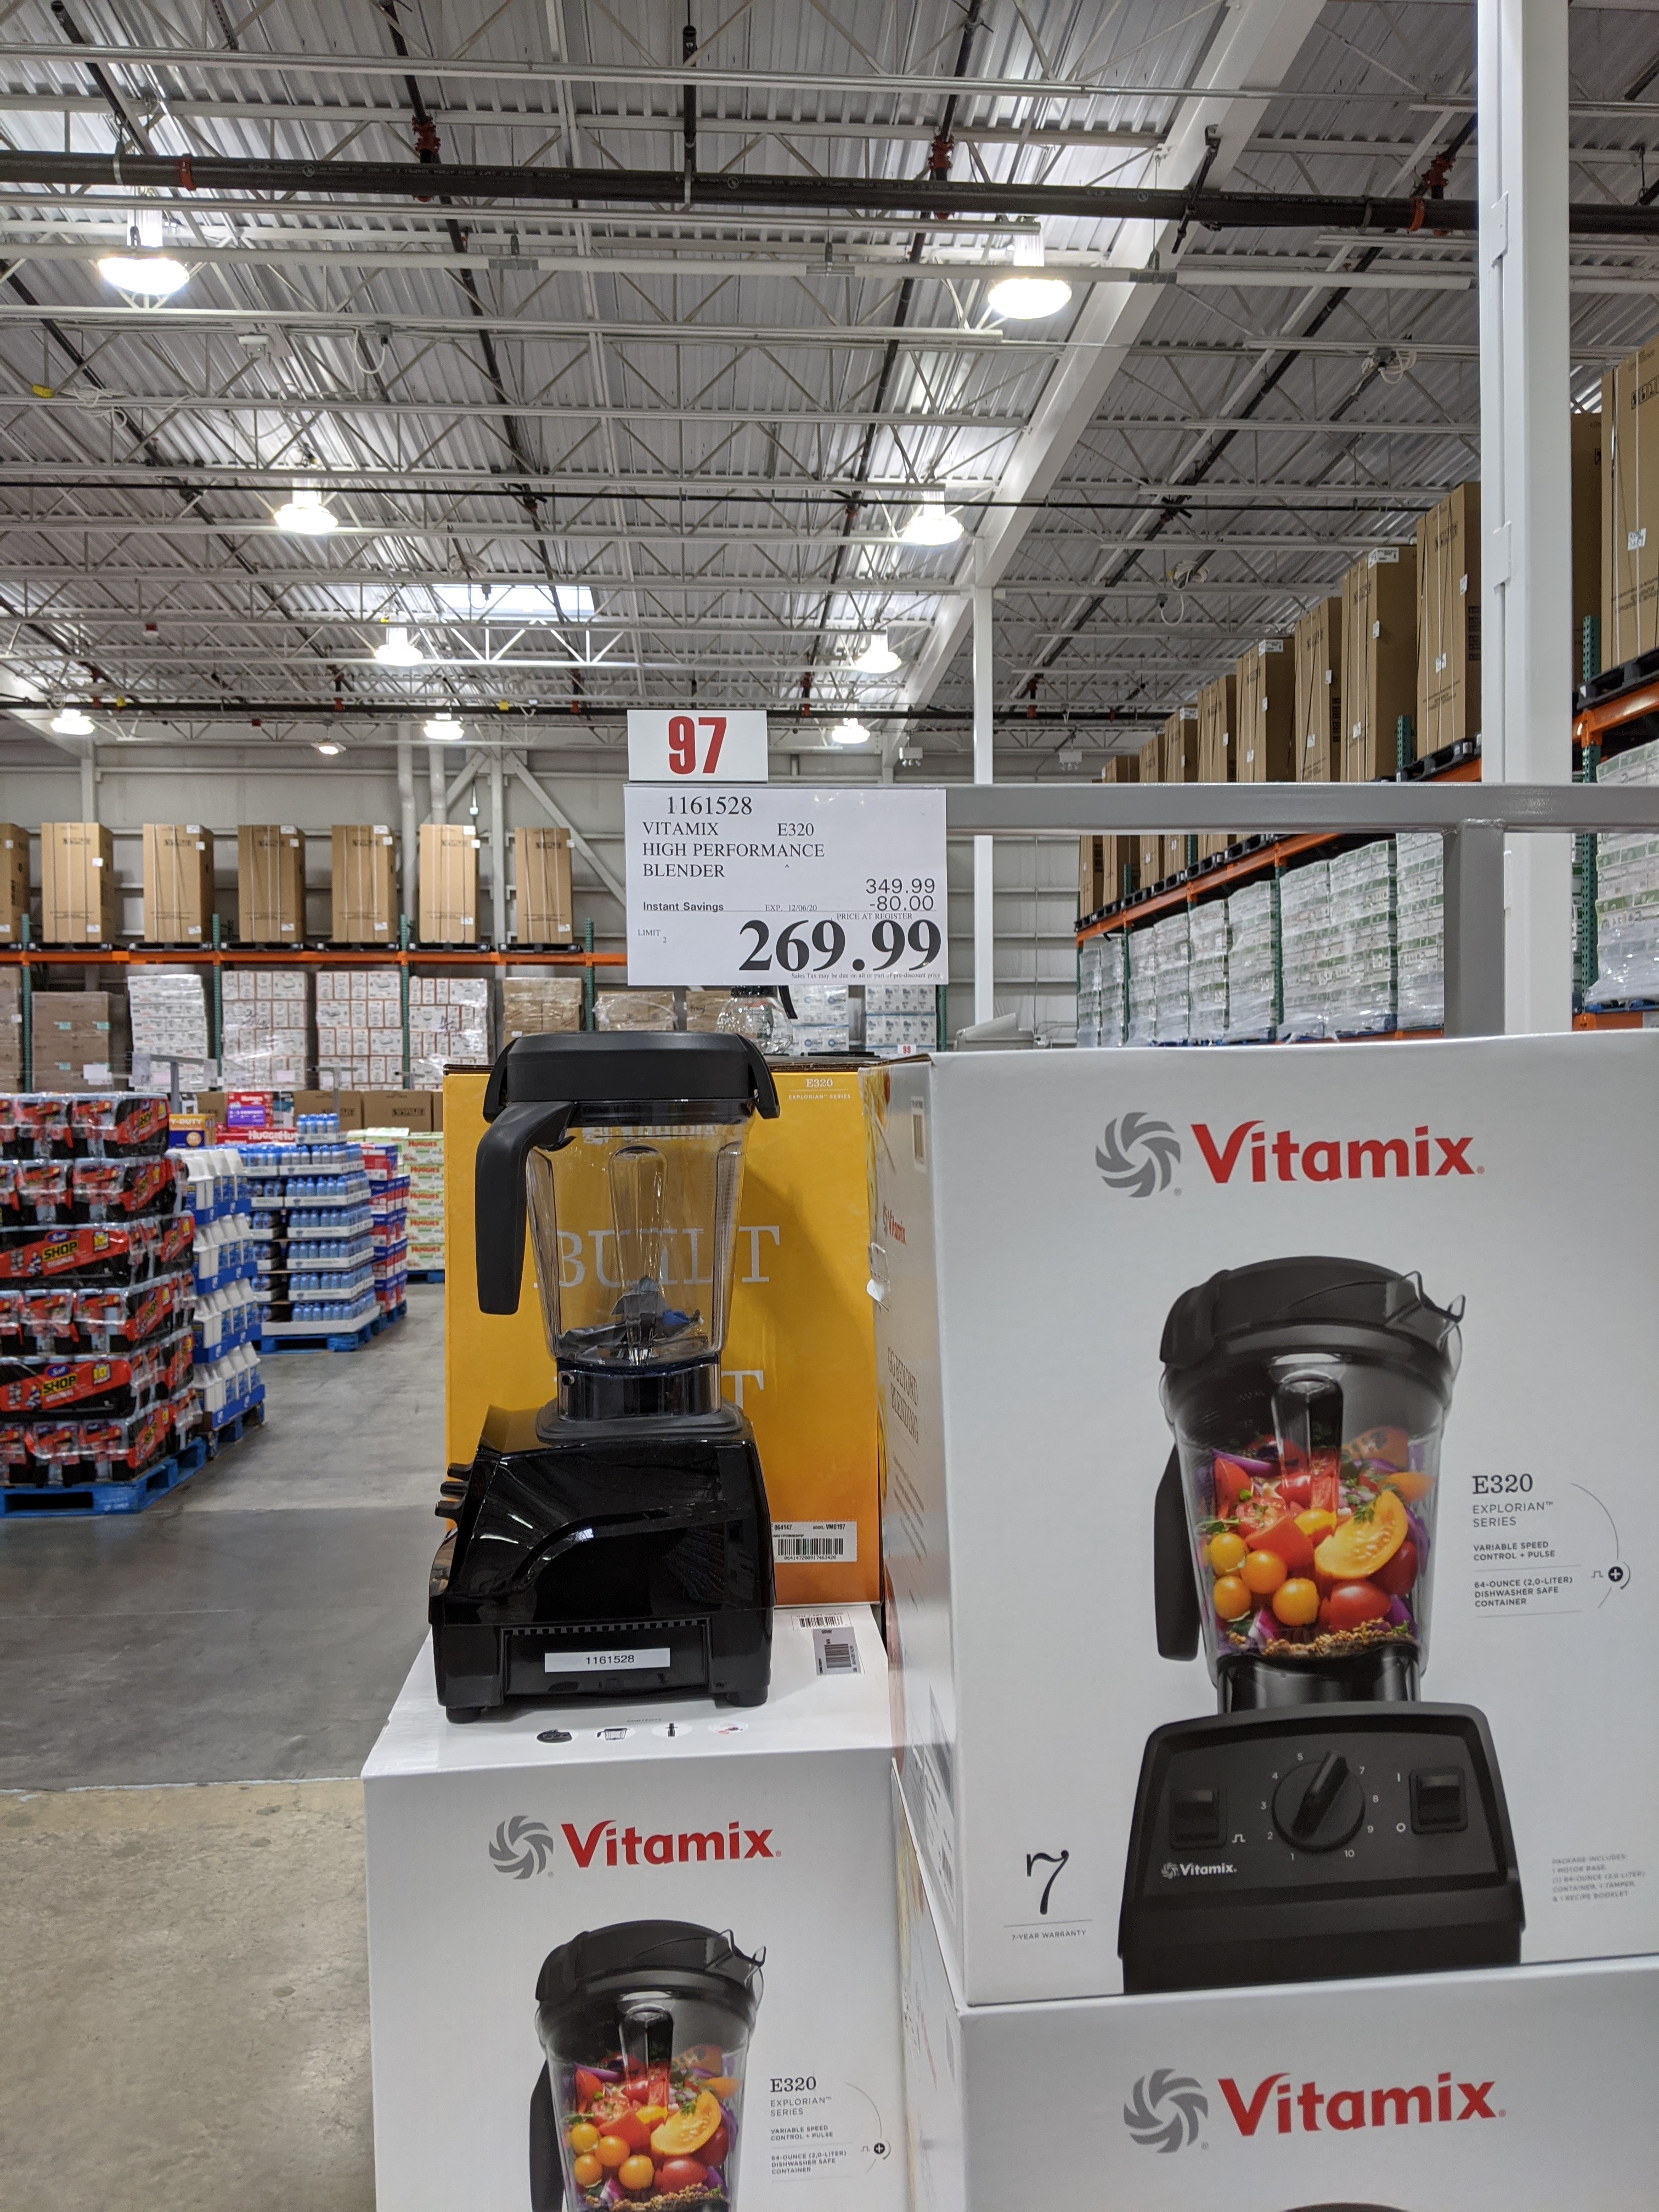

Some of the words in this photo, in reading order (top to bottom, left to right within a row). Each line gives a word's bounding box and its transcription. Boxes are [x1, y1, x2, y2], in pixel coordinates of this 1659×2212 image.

[668, 715, 727, 775] 97
[667, 796, 752, 815] 1161528
[642, 821, 719, 836] VITAMIX
[777, 823, 814, 837] E320
[642, 843, 686, 856] HIGH
[693, 843, 825, 857] PERFORMANCE
[643, 864, 725, 878] BLENDER
[866, 878, 935, 894] 349.99
[643, 901, 679, 911] Instant
[683, 901, 724, 912] Savings
[870, 895, 934, 911] -80.00
[739, 919, 941, 972] 269.99
[805, 1079, 833, 1087] E320
[1190, 1120, 1475, 1183] Vitamix
[44, 1242, 77, 1260] SHOP
[888, 1346, 895, 1379] GO
[895, 1355, 918, 1406] BEYOND
[43, 1375, 76, 1394] SHOP
[891, 1383, 919, 1445] BLENDING
[1471, 1474, 1533, 1494] E320
[1473, 1516, 1516, 1527] SERIES
[1474, 1543, 1517, 1552] VARIABLE
[1521, 1541, 1549, 1549] SPEED
[1474, 1552, 1517, 1561] CONTROL
[1528, 1550, 1555, 1558] PULSE
[1474, 1579, 1521, 1589] 64-OUNCE
[1475, 1587, 1533, 1598] DISHWASHER
[1537, 1586, 1559, 1594] SAFE
[1475, 1598, 1527, 1607] CONTAINER
[586, 1655, 635, 1664] 1161528
[1297, 1752, 1304, 1761] 5
[1272, 1771, 1278, 1780] 4
[1359, 1766, 1365, 1775] 7
[1373, 1795, 1379, 1803] 8
[1261, 1802, 1267, 1810] 3
[1367, 1825, 1374, 1833] 9
[1267, 1832, 1273, 1840] 2
[561, 1820, 774, 1867] Vitamix
[1290, 1852, 1295, 1861] 1
[1345, 1849, 1355, 1858] 10
[1180, 1863, 1234, 1876] Vitamix
[1026, 1849, 1069, 1915] 7
[1012, 1933, 1039, 1941] 7-YEAR
[1042, 1929, 1086, 1939] WARRANTY
[770, 2076, 816, 2092] E320
[1218, 2072, 1496, 2136] Vitamix
[770, 2108, 804, 2117] SERIES
[771, 2159, 816, 2168] DISHWASHER
